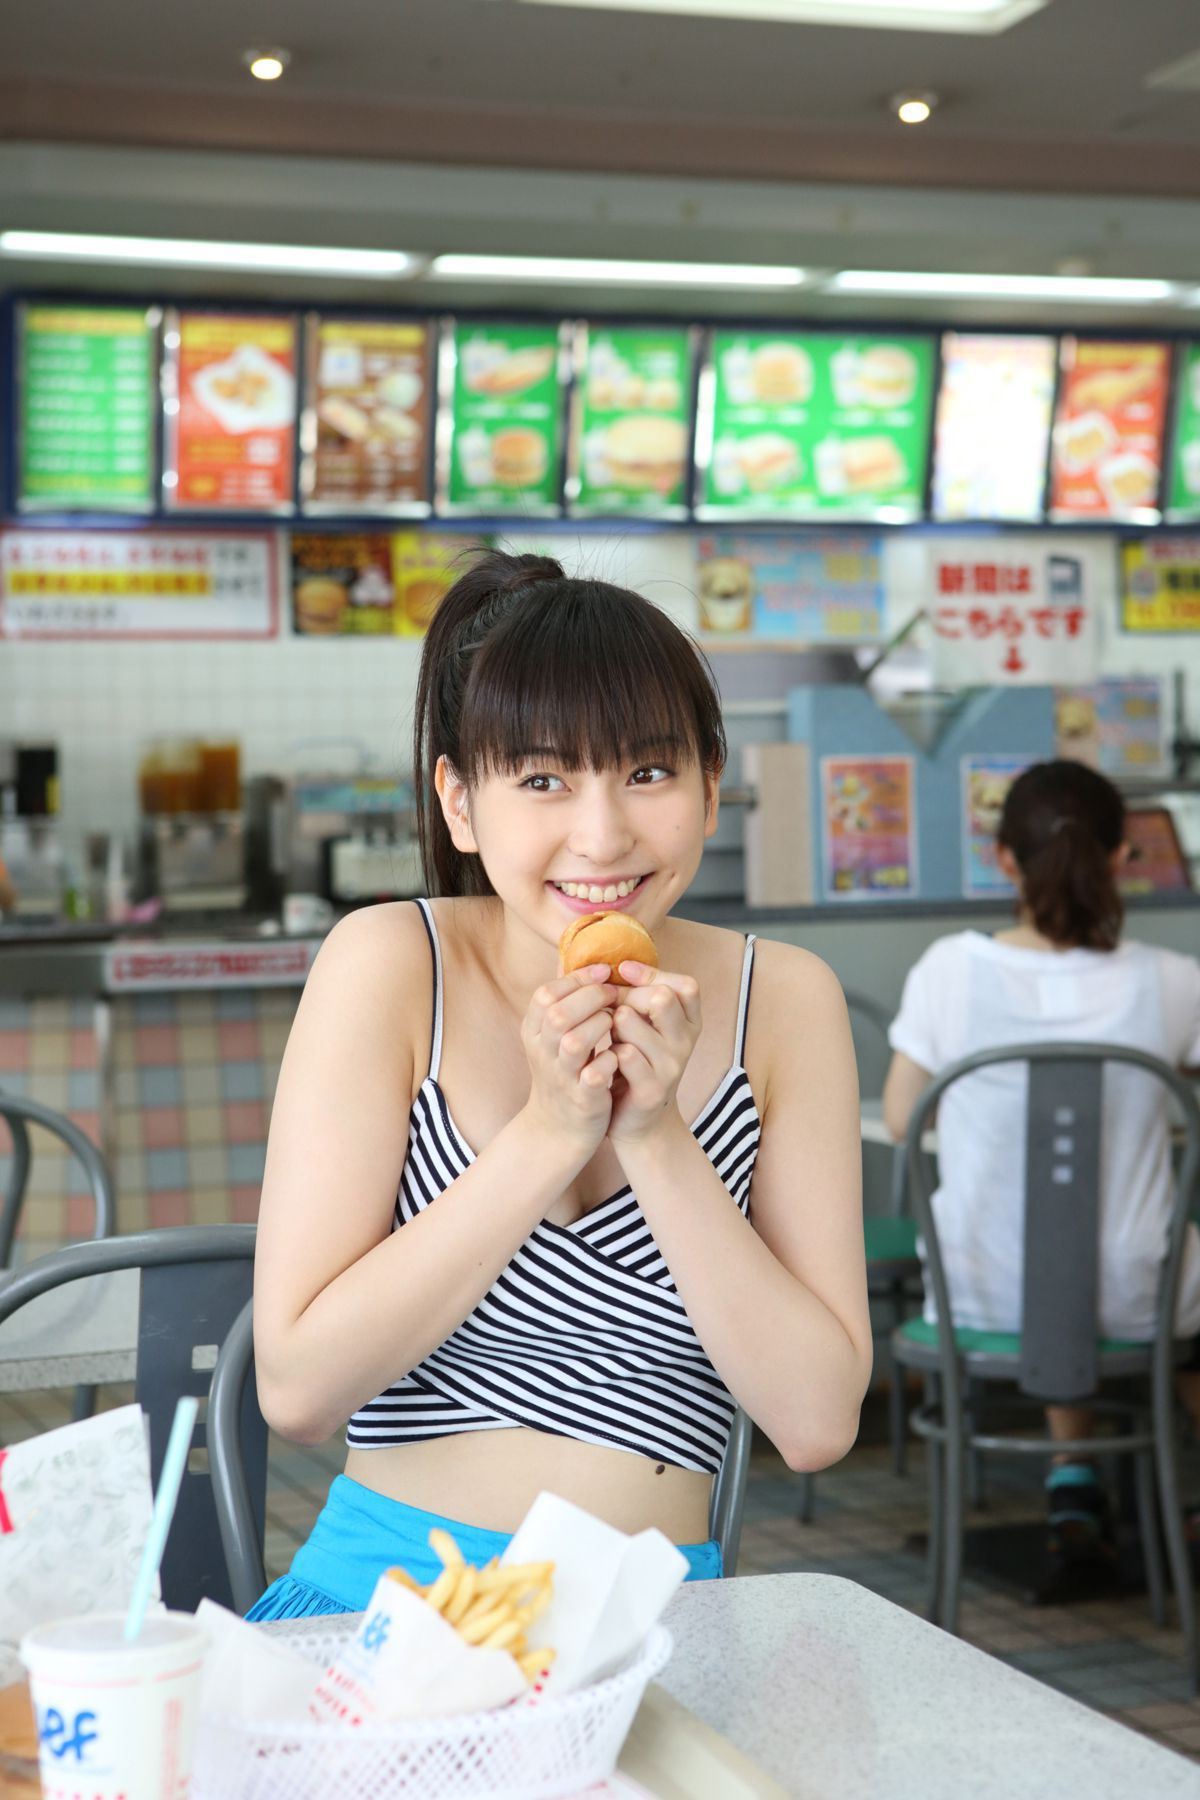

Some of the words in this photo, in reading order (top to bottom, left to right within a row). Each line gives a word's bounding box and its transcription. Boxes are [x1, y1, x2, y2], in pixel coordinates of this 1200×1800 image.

[932, 605, 1086, 640] こちらです
[39, 1707, 98, 1761] ef
